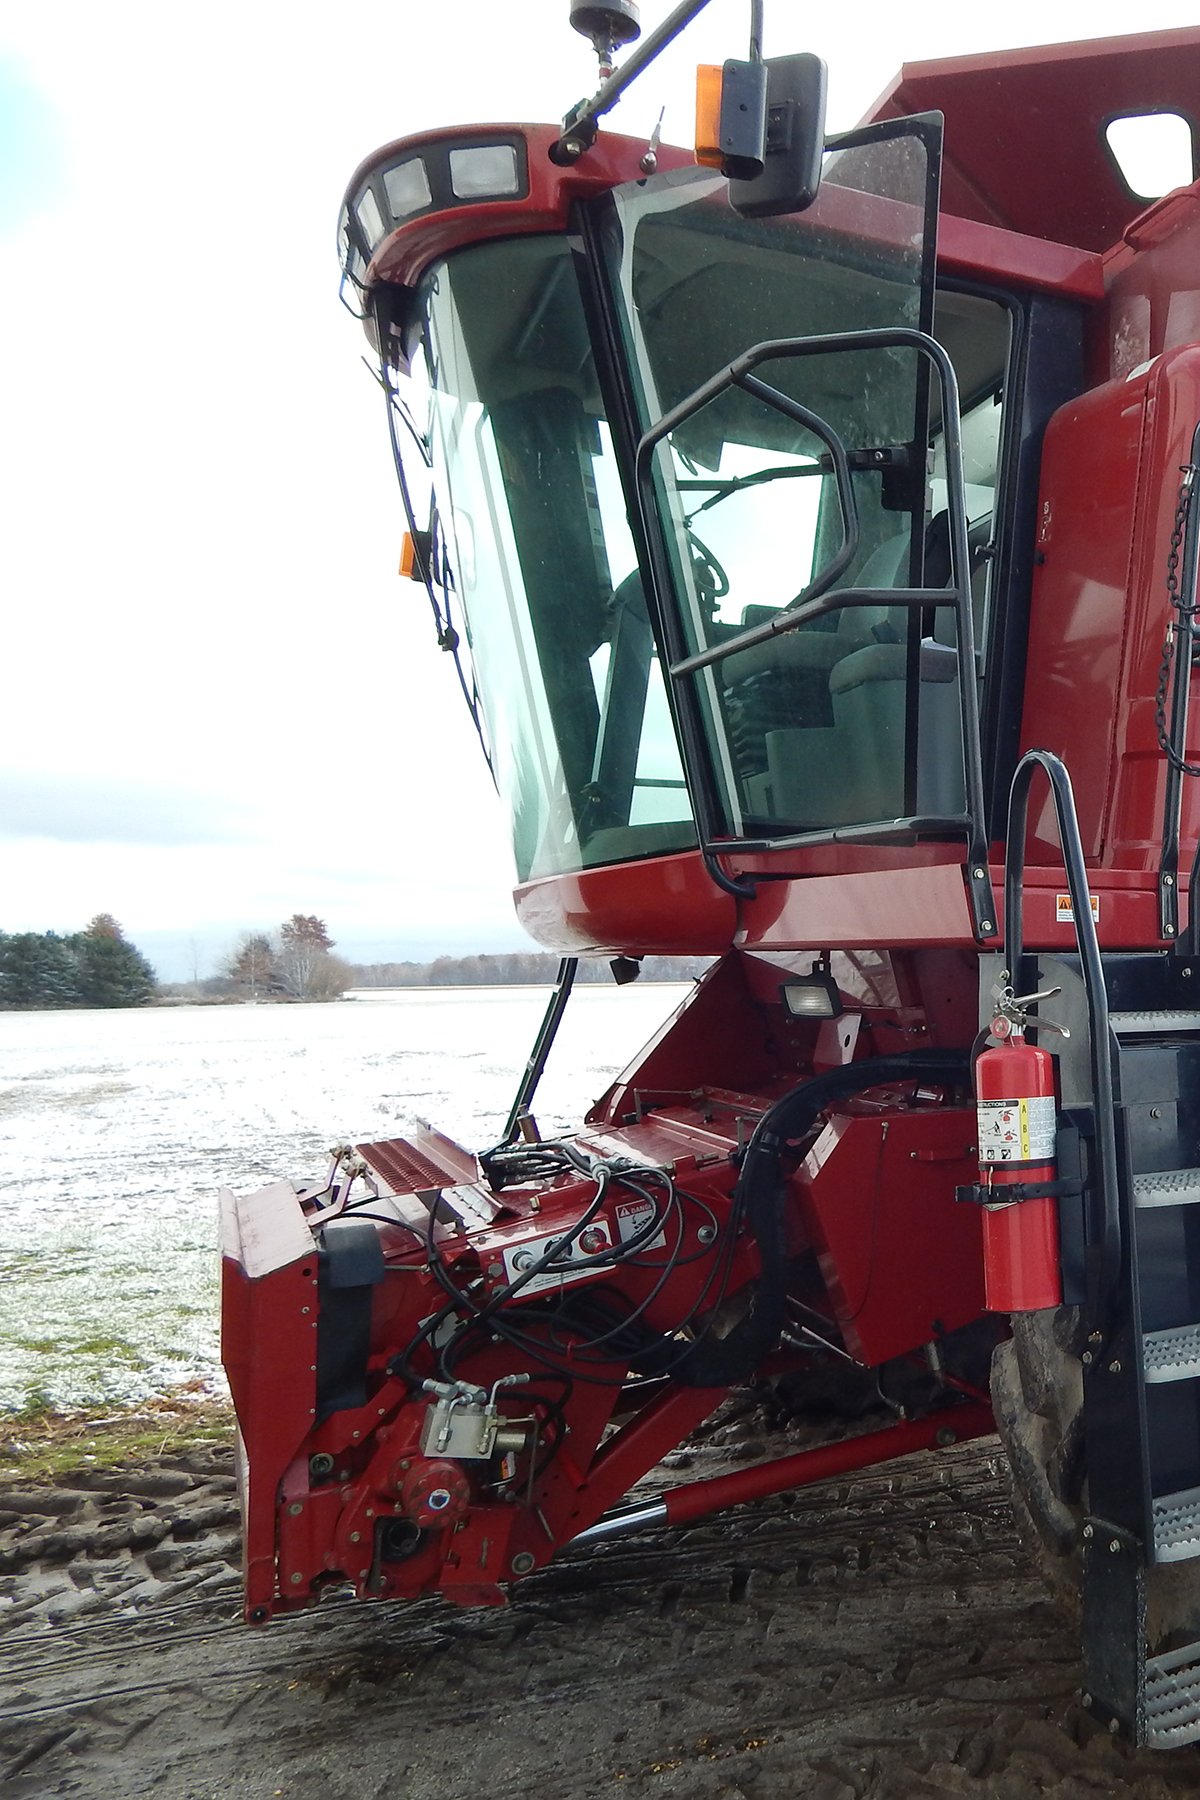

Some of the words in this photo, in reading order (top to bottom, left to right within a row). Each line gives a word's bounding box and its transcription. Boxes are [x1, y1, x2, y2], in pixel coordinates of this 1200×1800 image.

[1021, 1104, 1027, 1114] A
[1022, 1124, 1028, 1134] B
[1023, 1143, 1029, 1153] C
